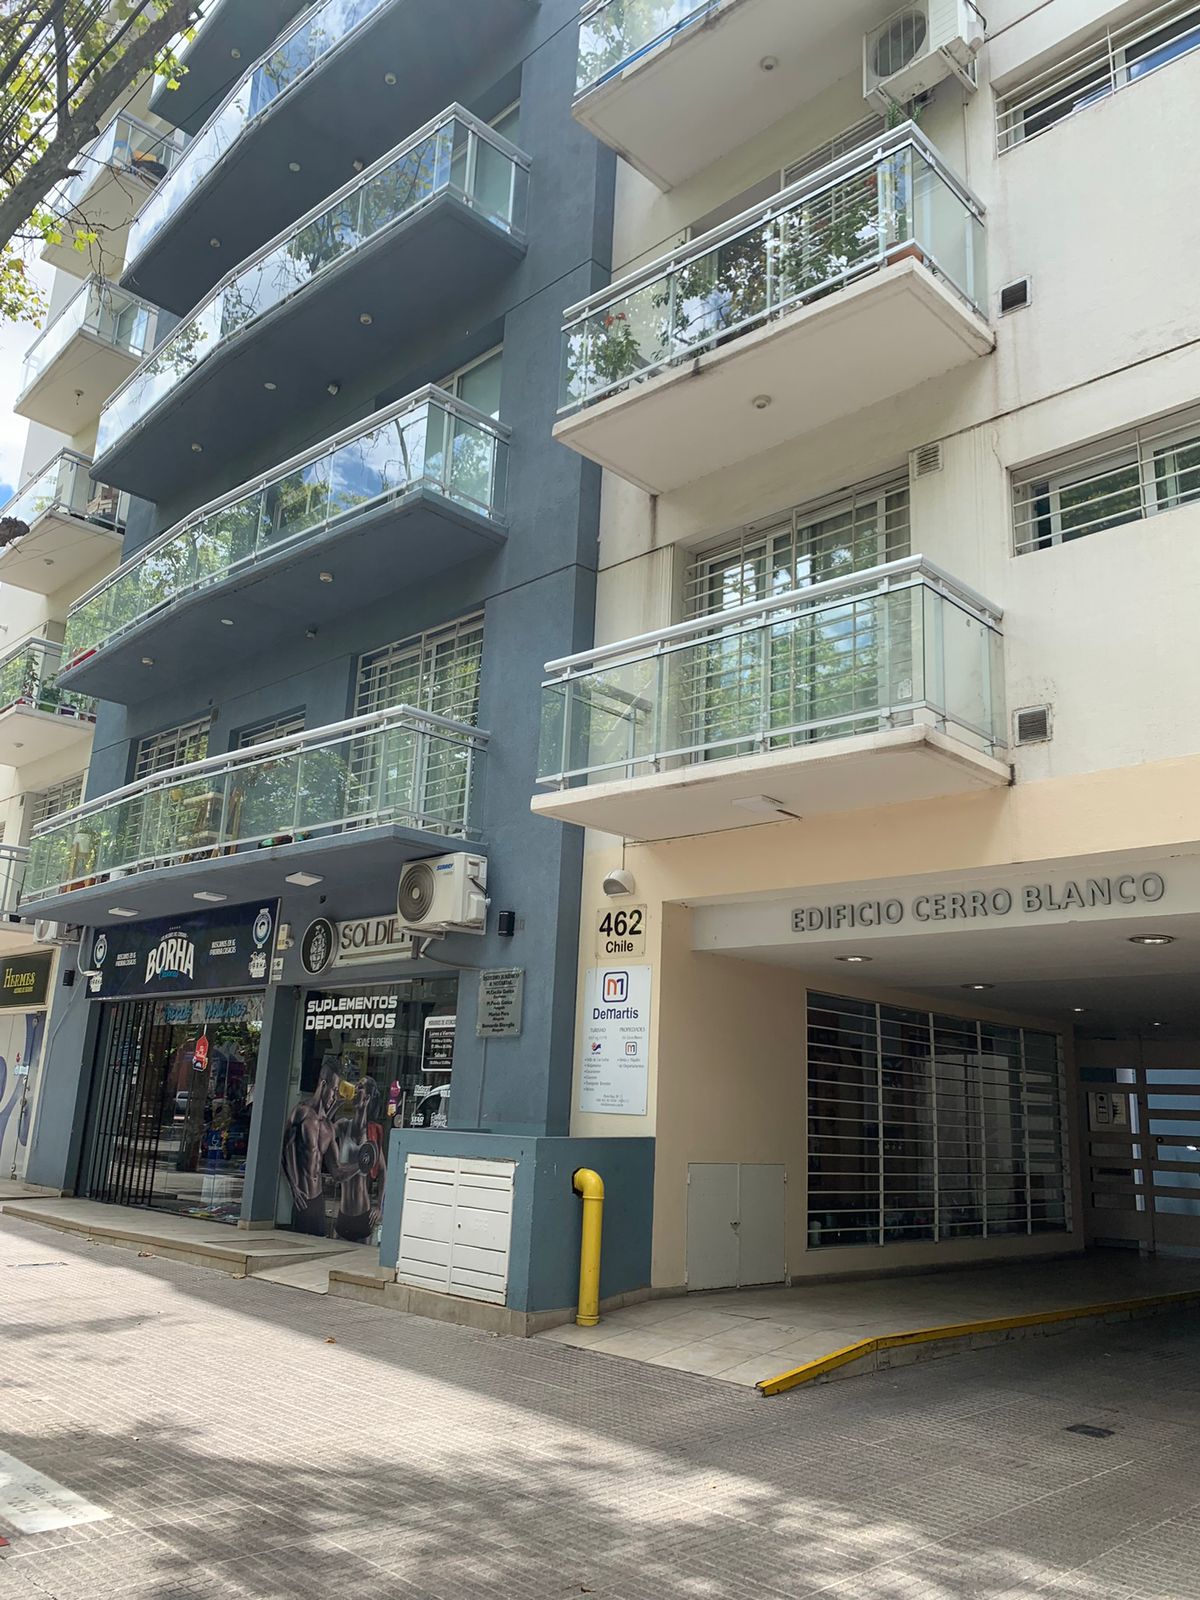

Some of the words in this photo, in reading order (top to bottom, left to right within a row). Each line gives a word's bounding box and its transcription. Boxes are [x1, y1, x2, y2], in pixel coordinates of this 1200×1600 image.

[791, 899, 904, 932] EDIFICIO
[911, 887, 1012, 922] CERRO
[1022, 872, 1165, 913] BLANCO
[599, 909, 643, 937] 462
[605, 940, 634, 953] Chile
[145, 938, 195, 984] BORHA
[3, 967, 36, 988] HERMES
[307, 995, 398, 1013] SUPLEMENTOS
[305, 1013, 396, 1031] DEPORTIVOS
